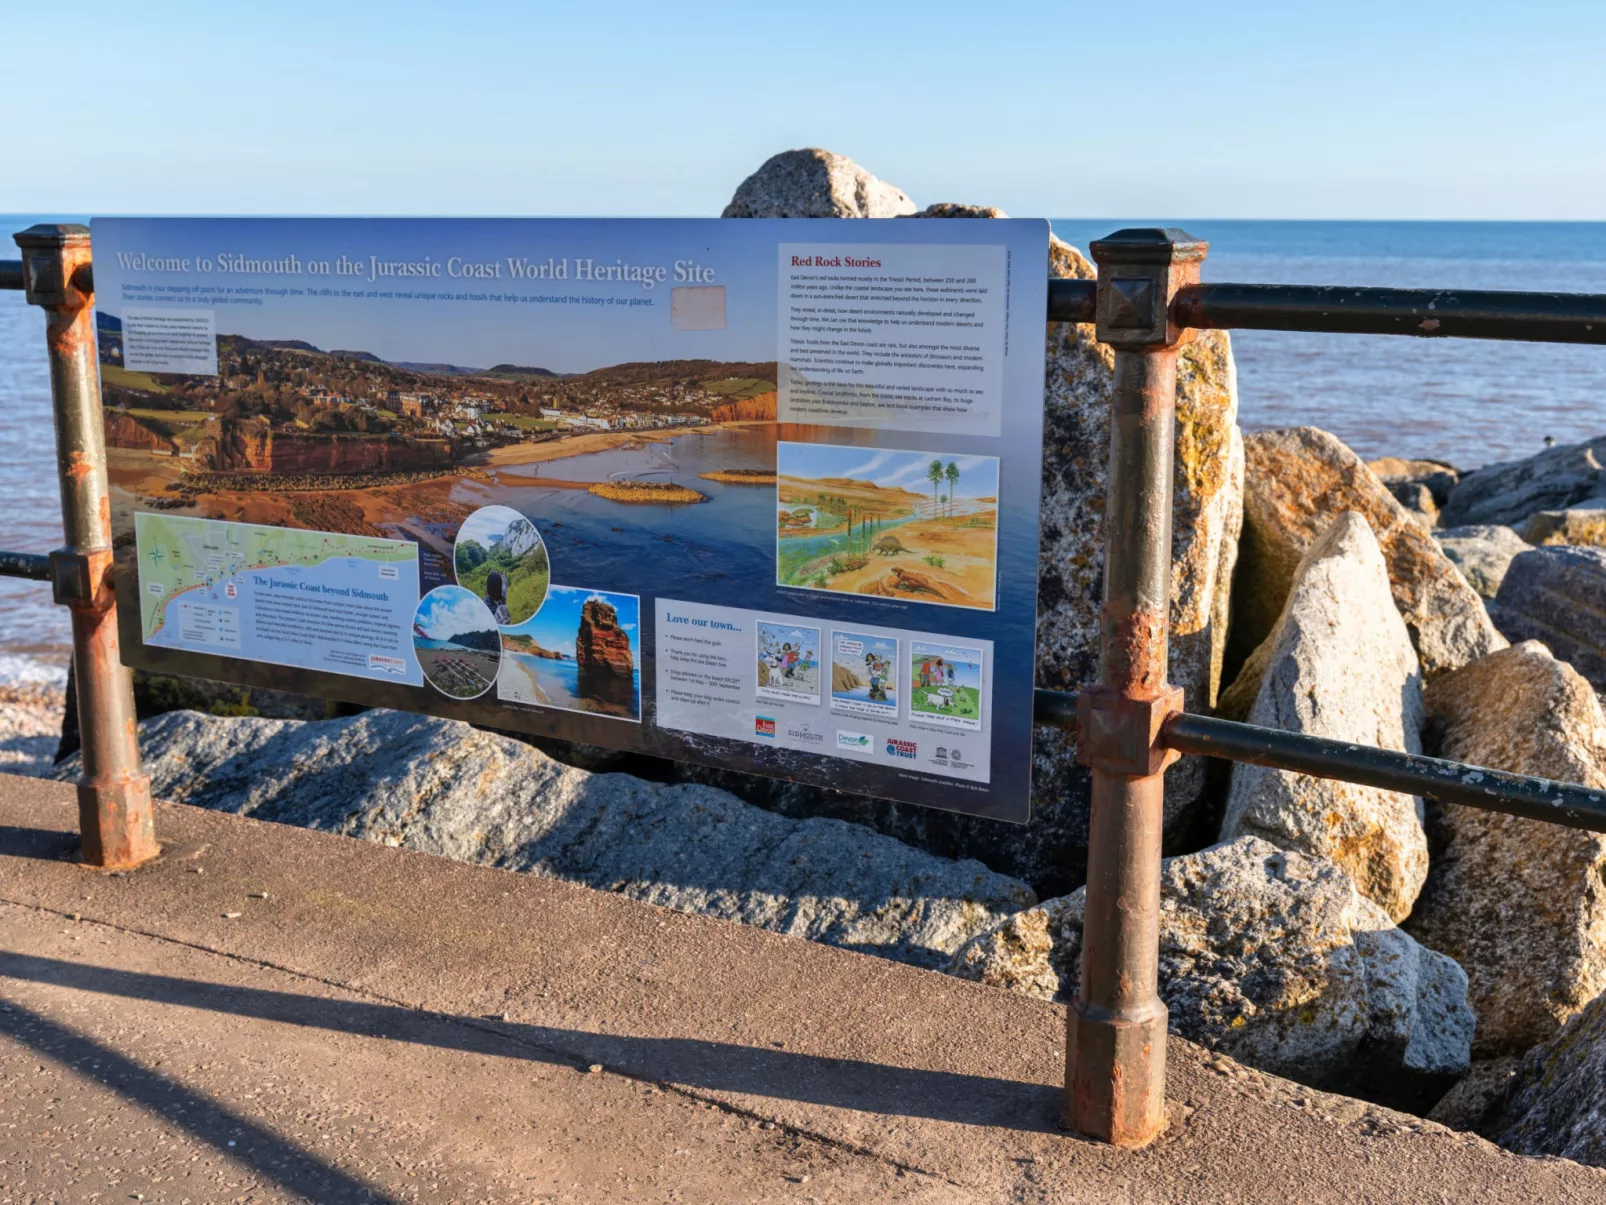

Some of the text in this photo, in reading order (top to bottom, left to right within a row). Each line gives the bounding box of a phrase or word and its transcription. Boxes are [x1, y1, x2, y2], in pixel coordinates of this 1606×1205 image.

[791, 256, 882, 268] Red Rock Stories
[117, 252, 716, 288] Welcome to Sidmouth on the Jurassic Coast World Heritage Site
[167, 285, 191, 294] stepping
[200, 286, 216, 294] point
[265, 288, 289, 297] through
[414, 291, 436, 301] unique
[469, 293, 488, 301] fossils
[504, 294, 518, 304] help
[530, 295, 567, 303] understand
[582, 296, 604, 306] history
[630, 298, 655, 307] planet.
[253, 576, 389, 602] The Jurassic Coast beyond Sidmouth
[667, 613, 742, 633] Love our town...
[762, 720, 774, 729] East
[788, 730, 824, 741] SIDMOUTH
[838, 734, 858, 743] Devon
[886, 738, 917, 748] JURASSIC
[896, 746, 917, 754] COAST
[896, 751, 917, 760] TRUST
